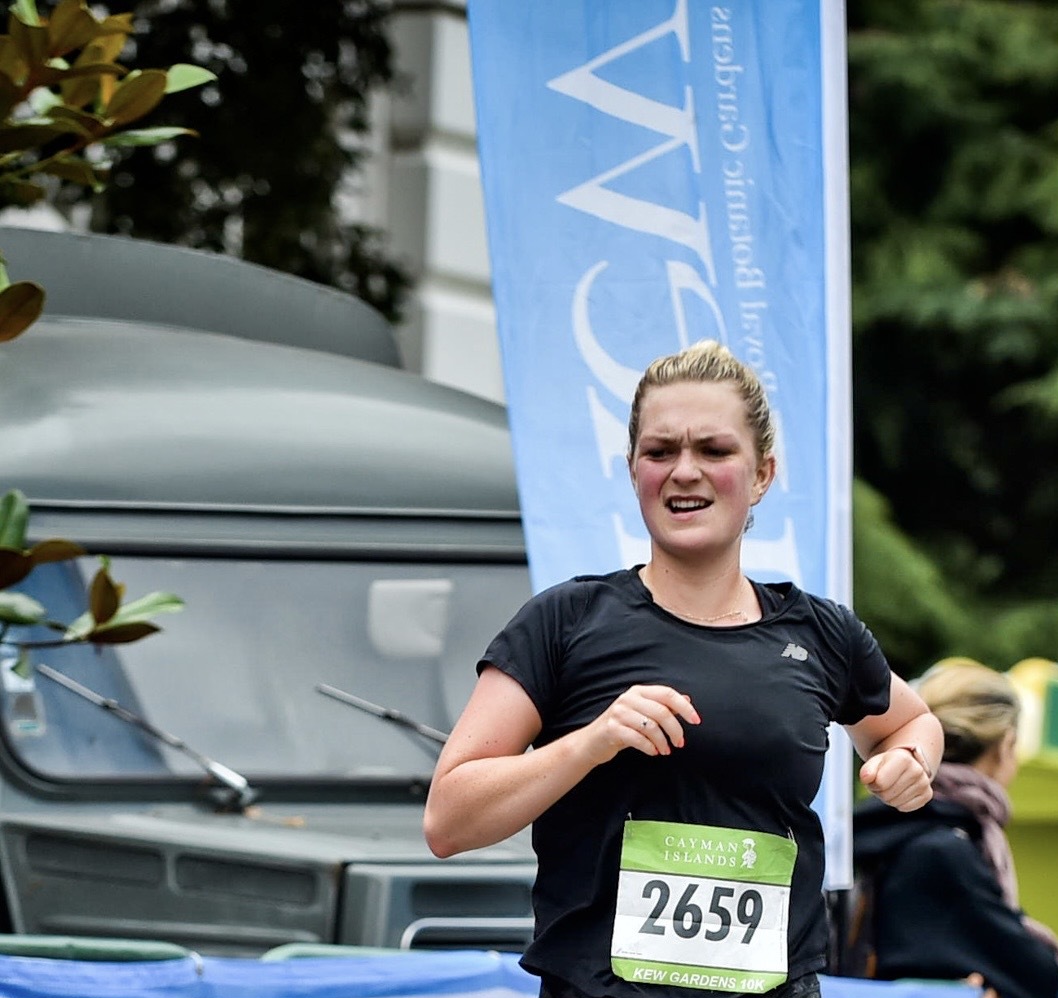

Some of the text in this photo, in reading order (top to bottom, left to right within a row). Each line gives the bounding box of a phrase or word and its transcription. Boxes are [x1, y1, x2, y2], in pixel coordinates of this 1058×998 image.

[664, 835, 738, 853] CAYMAN
[664, 851, 737, 867] ISLANDS
[638, 879, 763, 945] 2659
[633, 967, 766, 991] KEW GARDENS 10K
